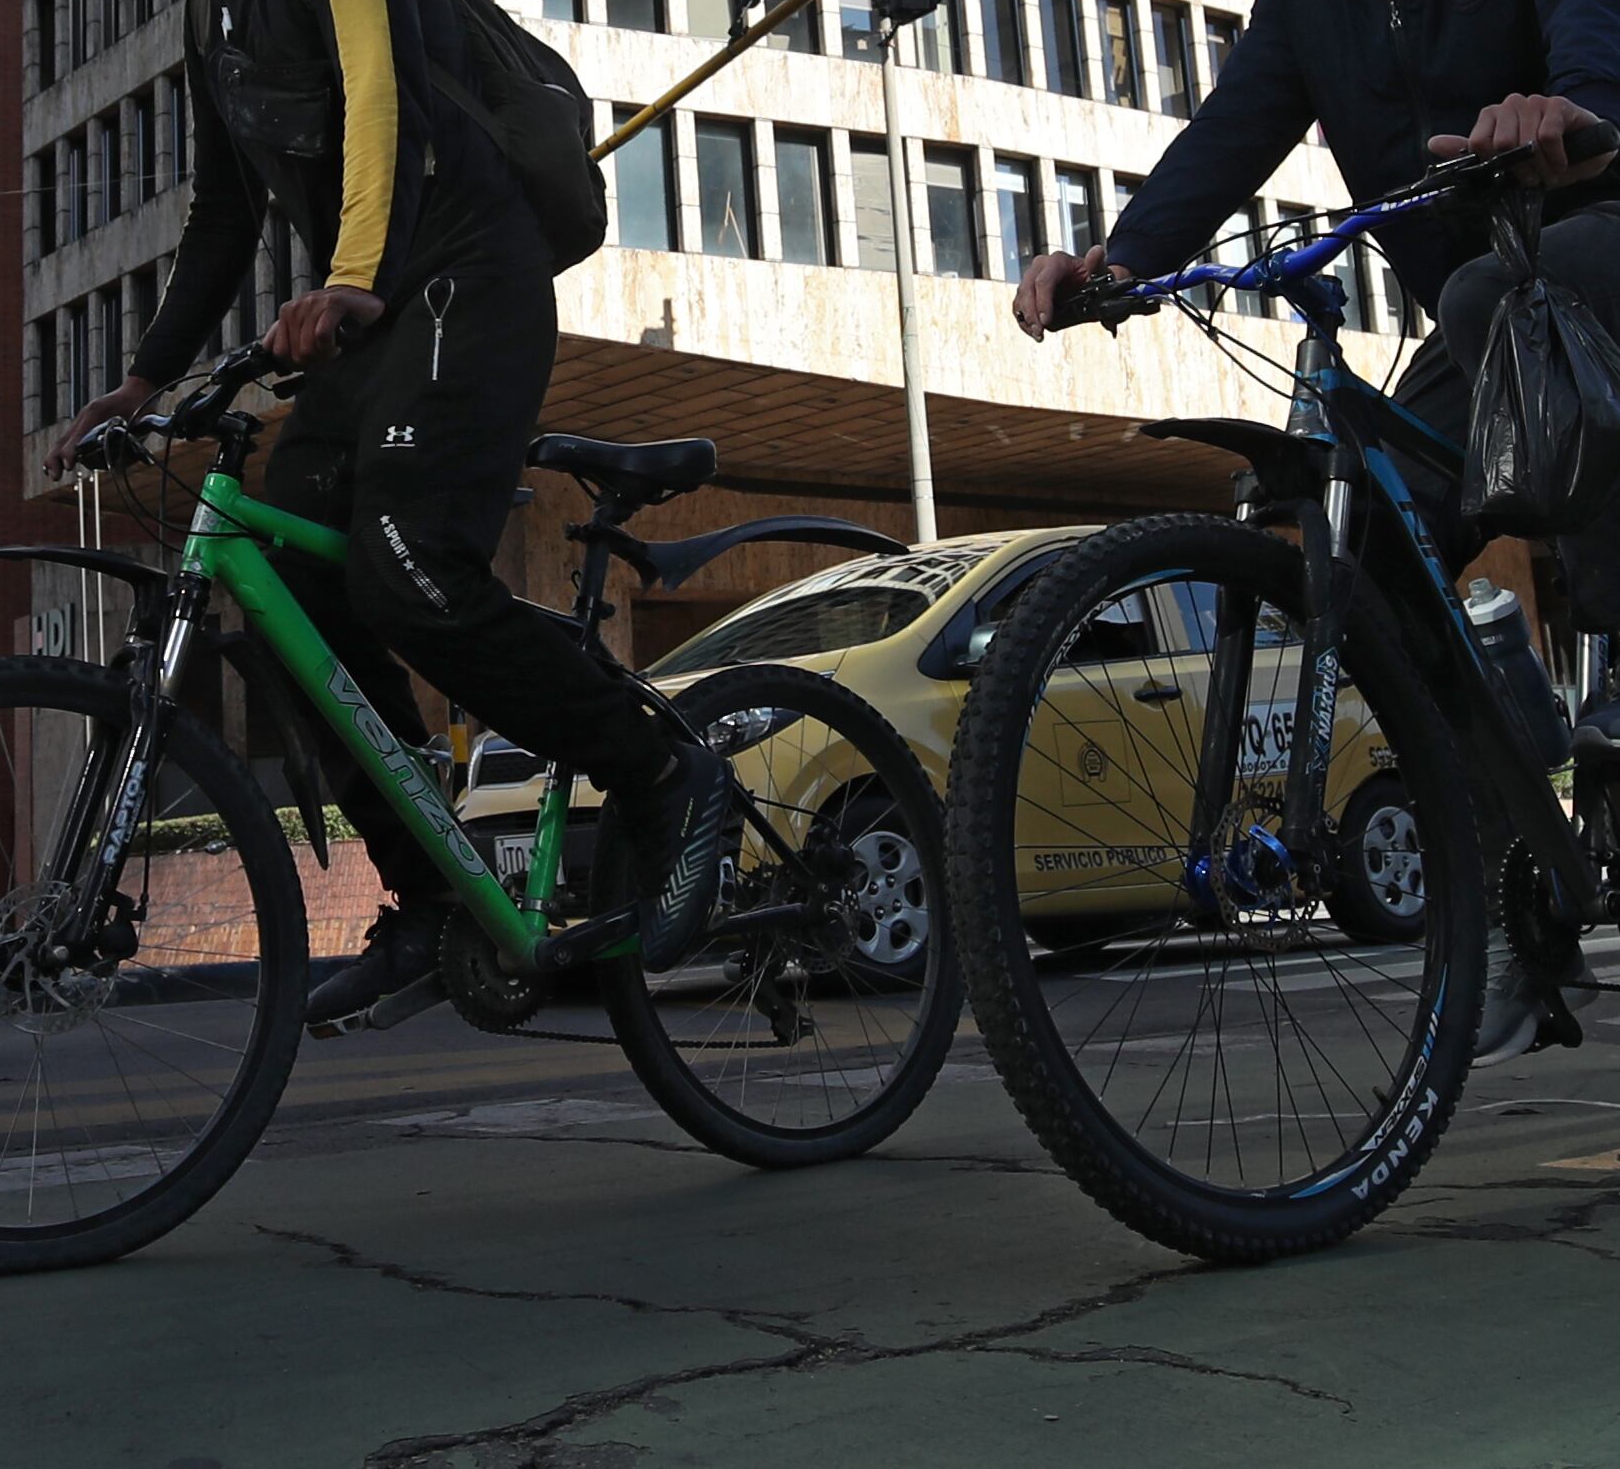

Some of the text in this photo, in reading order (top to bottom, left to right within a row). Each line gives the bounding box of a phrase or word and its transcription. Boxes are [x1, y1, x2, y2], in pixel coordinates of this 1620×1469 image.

[383, 522, 411, 560] SPORT
[32, 603, 75, 658] HDI
[103, 760, 148, 865] RAPTOR
[1034, 850, 1103, 872] SERVICIO
[1351, 1086, 1439, 1202] KENDA
